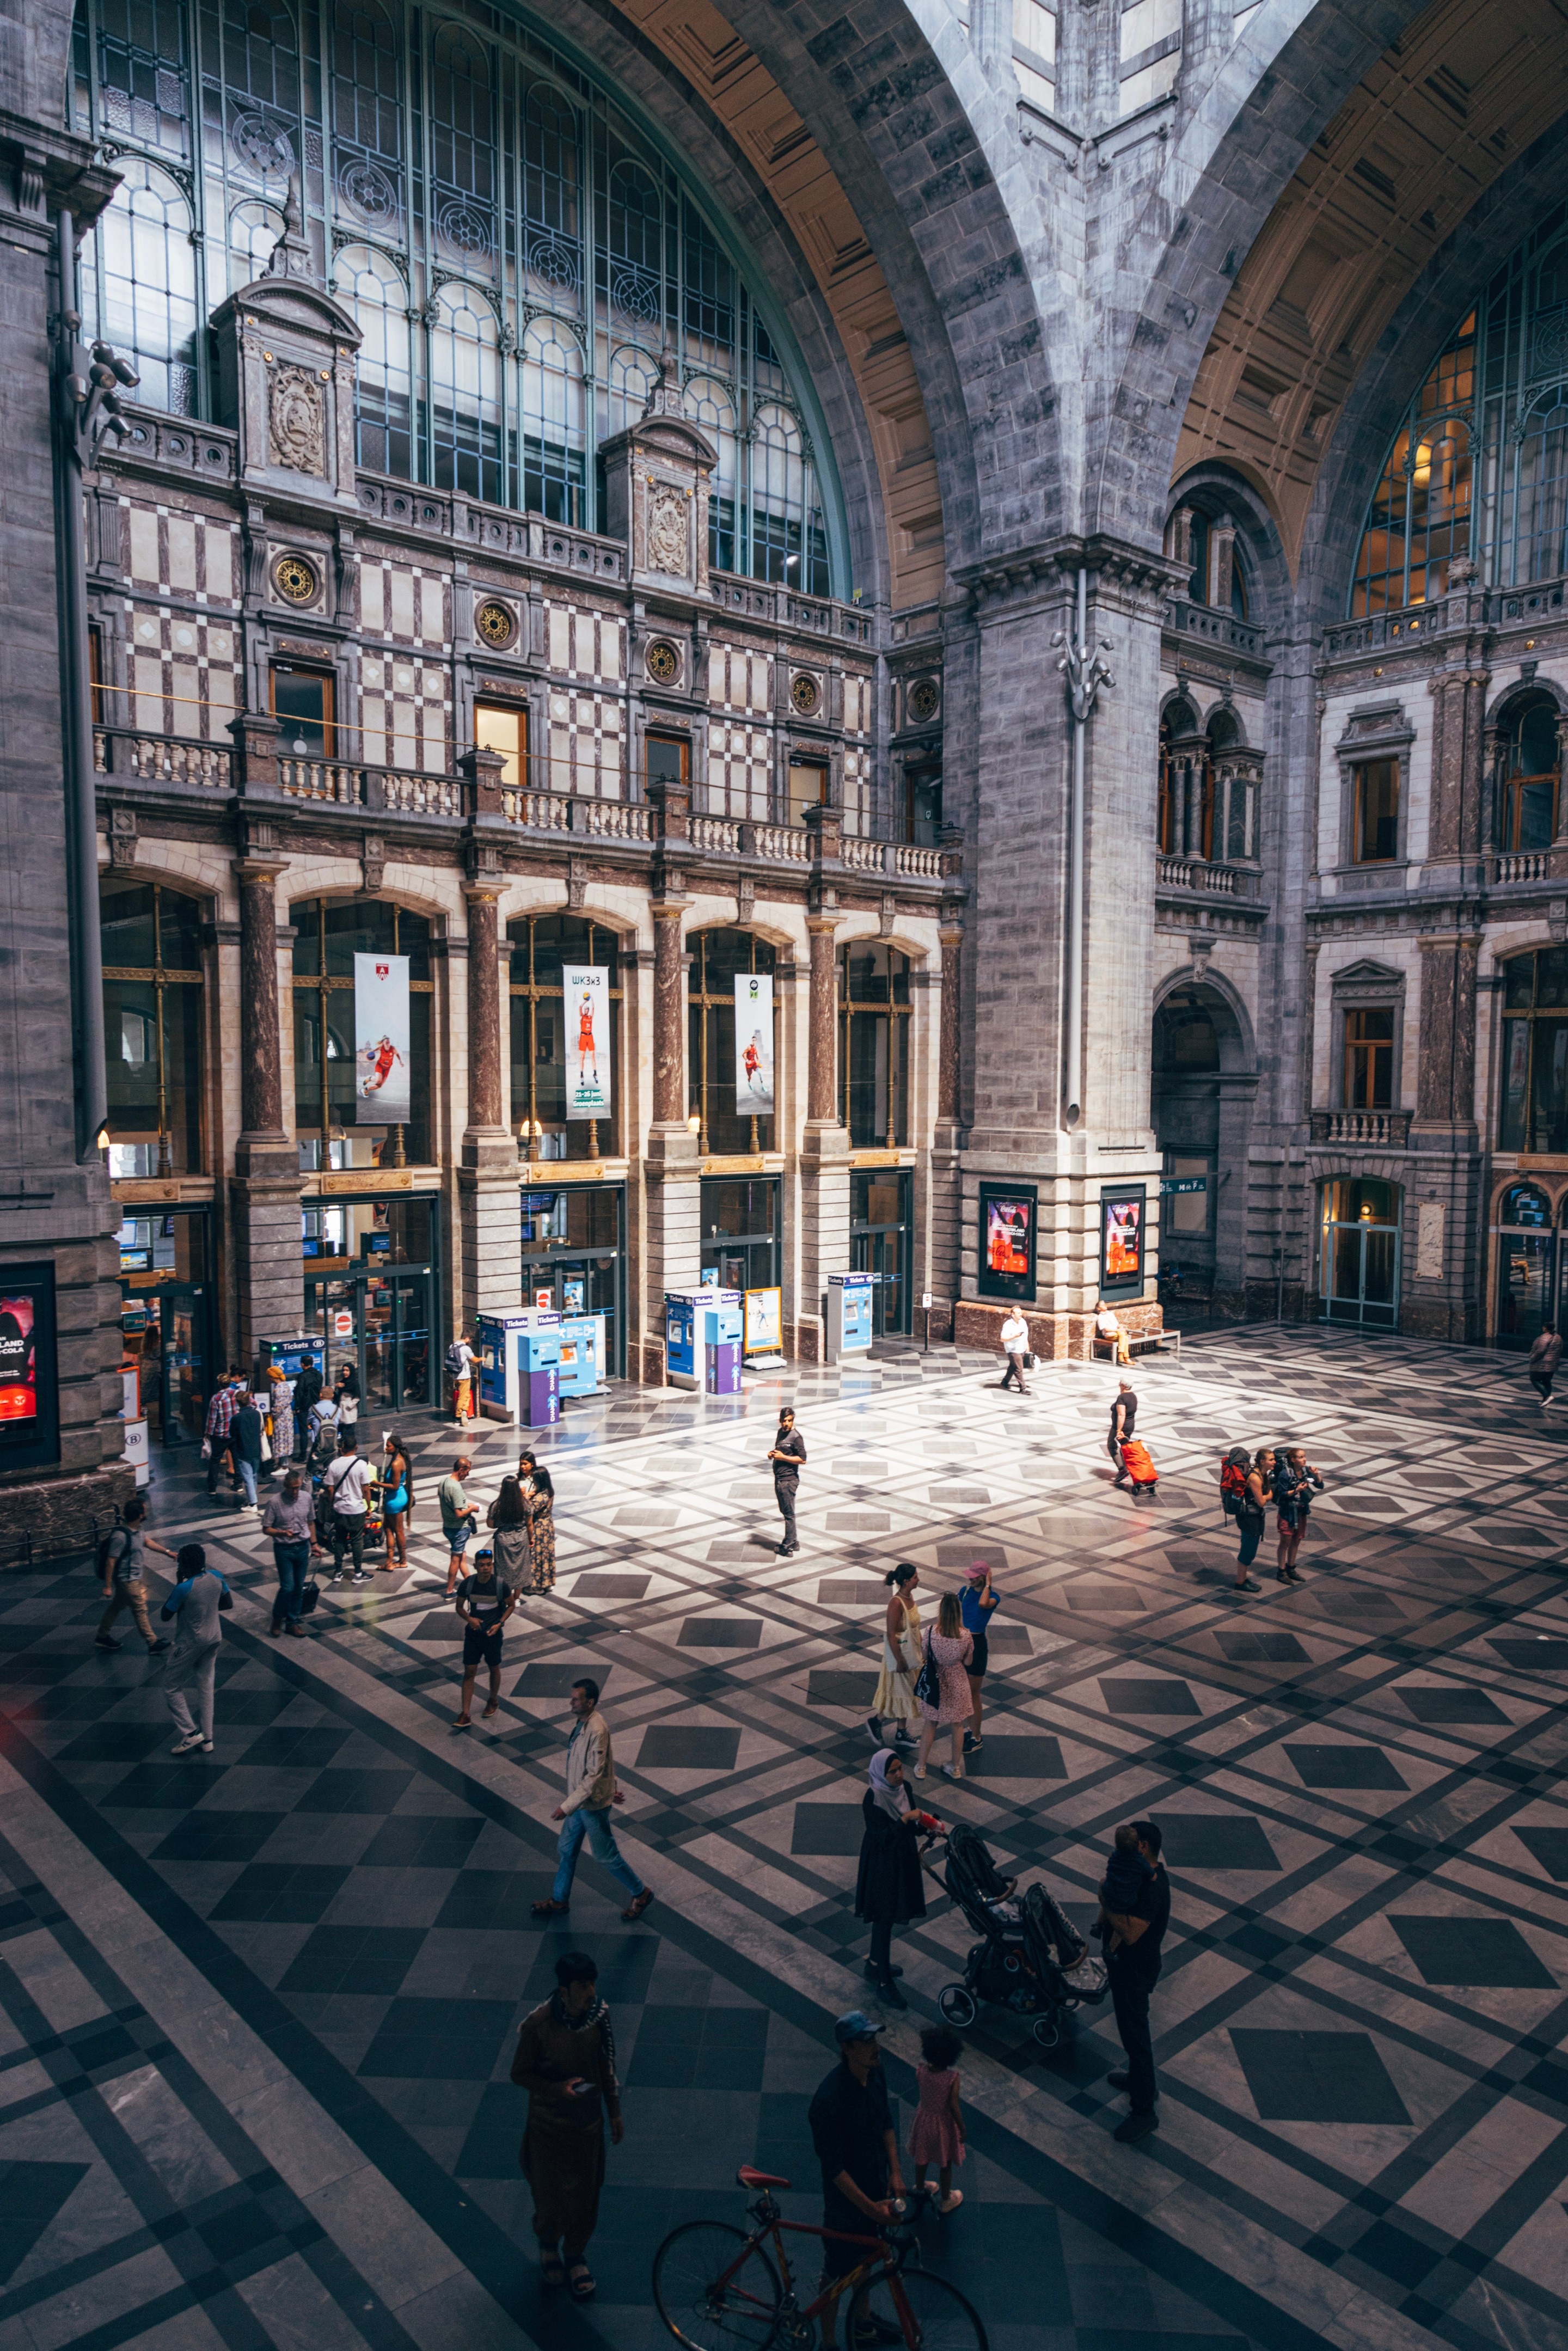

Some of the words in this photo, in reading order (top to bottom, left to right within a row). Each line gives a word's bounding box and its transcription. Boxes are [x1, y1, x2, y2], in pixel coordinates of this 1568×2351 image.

[669, 1295, 684, 1303] Tickets
[481, 1317, 495, 1326] Tickets
[283, 1342, 309, 1350] Tickets
